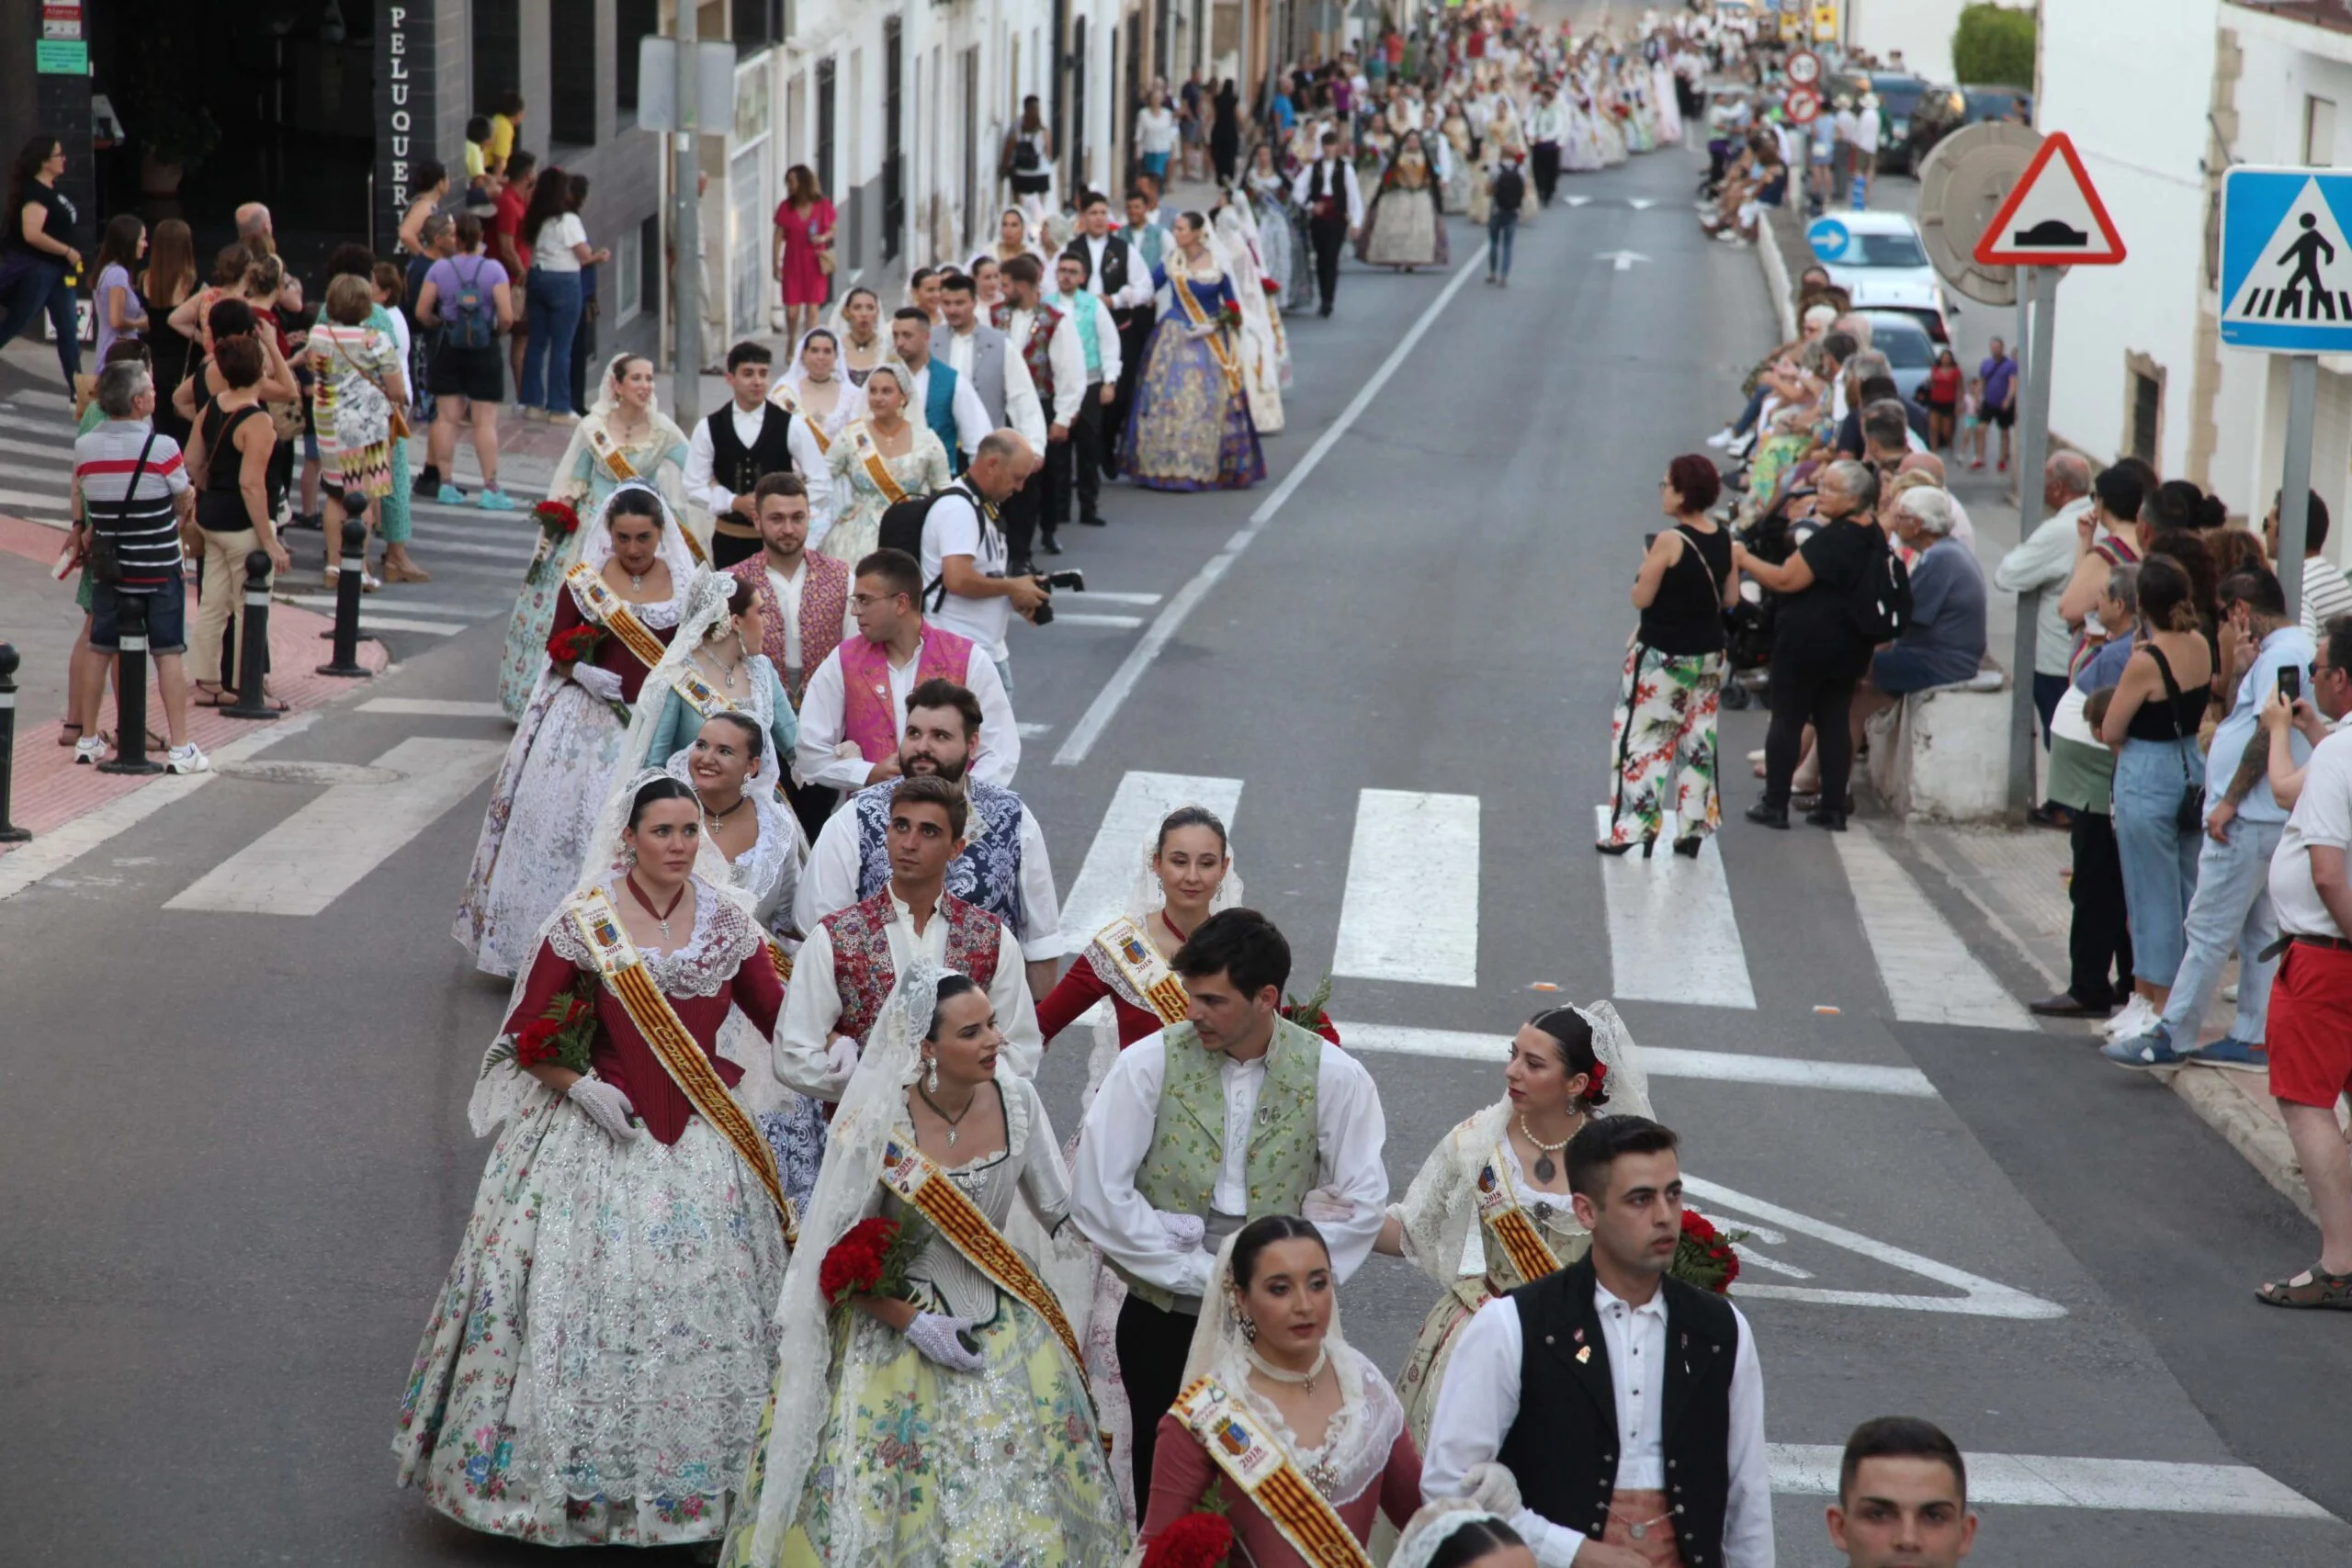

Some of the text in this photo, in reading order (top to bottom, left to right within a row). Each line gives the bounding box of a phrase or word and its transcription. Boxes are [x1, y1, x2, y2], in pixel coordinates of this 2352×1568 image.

[604, 942, 624, 957] 2018
[1135, 958, 1153, 974] 2018
[894, 1156, 913, 1178] 2018
[1484, 1190, 1502, 1204] 2018
[1238, 1445, 1262, 1469] 2018
